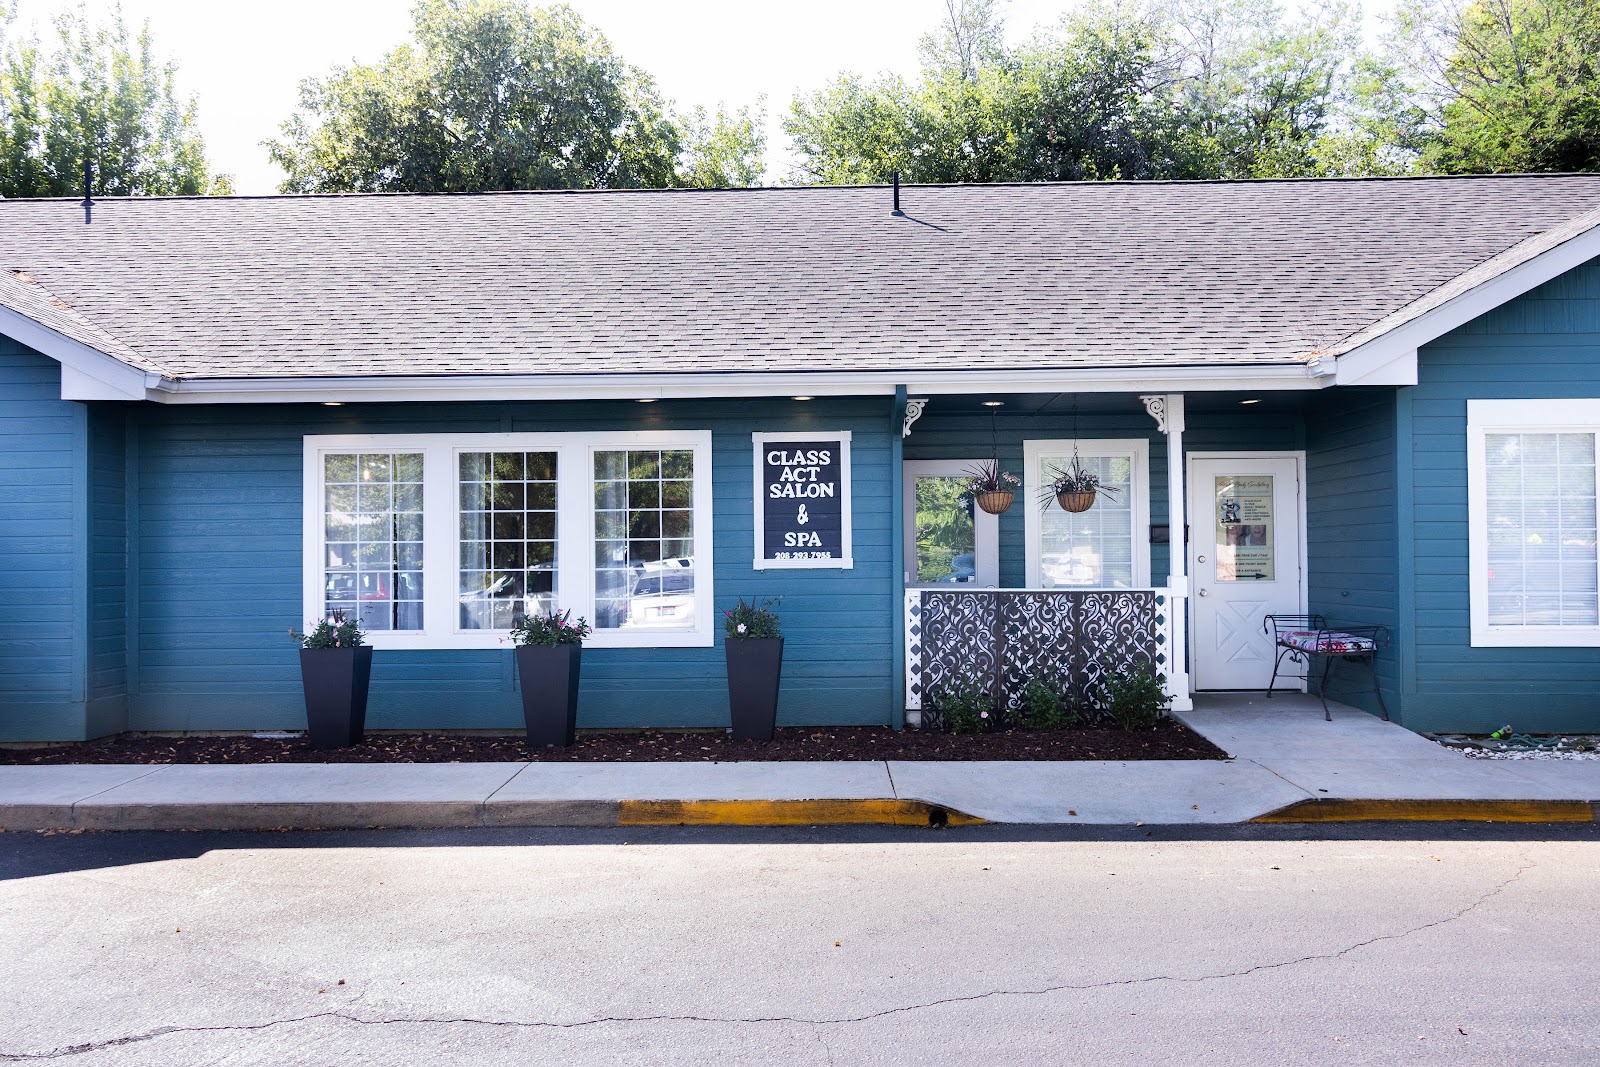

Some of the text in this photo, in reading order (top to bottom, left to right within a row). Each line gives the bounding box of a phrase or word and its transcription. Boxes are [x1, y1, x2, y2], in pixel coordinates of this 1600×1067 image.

[767, 450, 831, 466] CLASS
[780, 466, 820, 482] ACT
[769, 482, 834, 498] SALON
[797, 504, 809, 524] &
[784, 531, 822, 547] SPA
